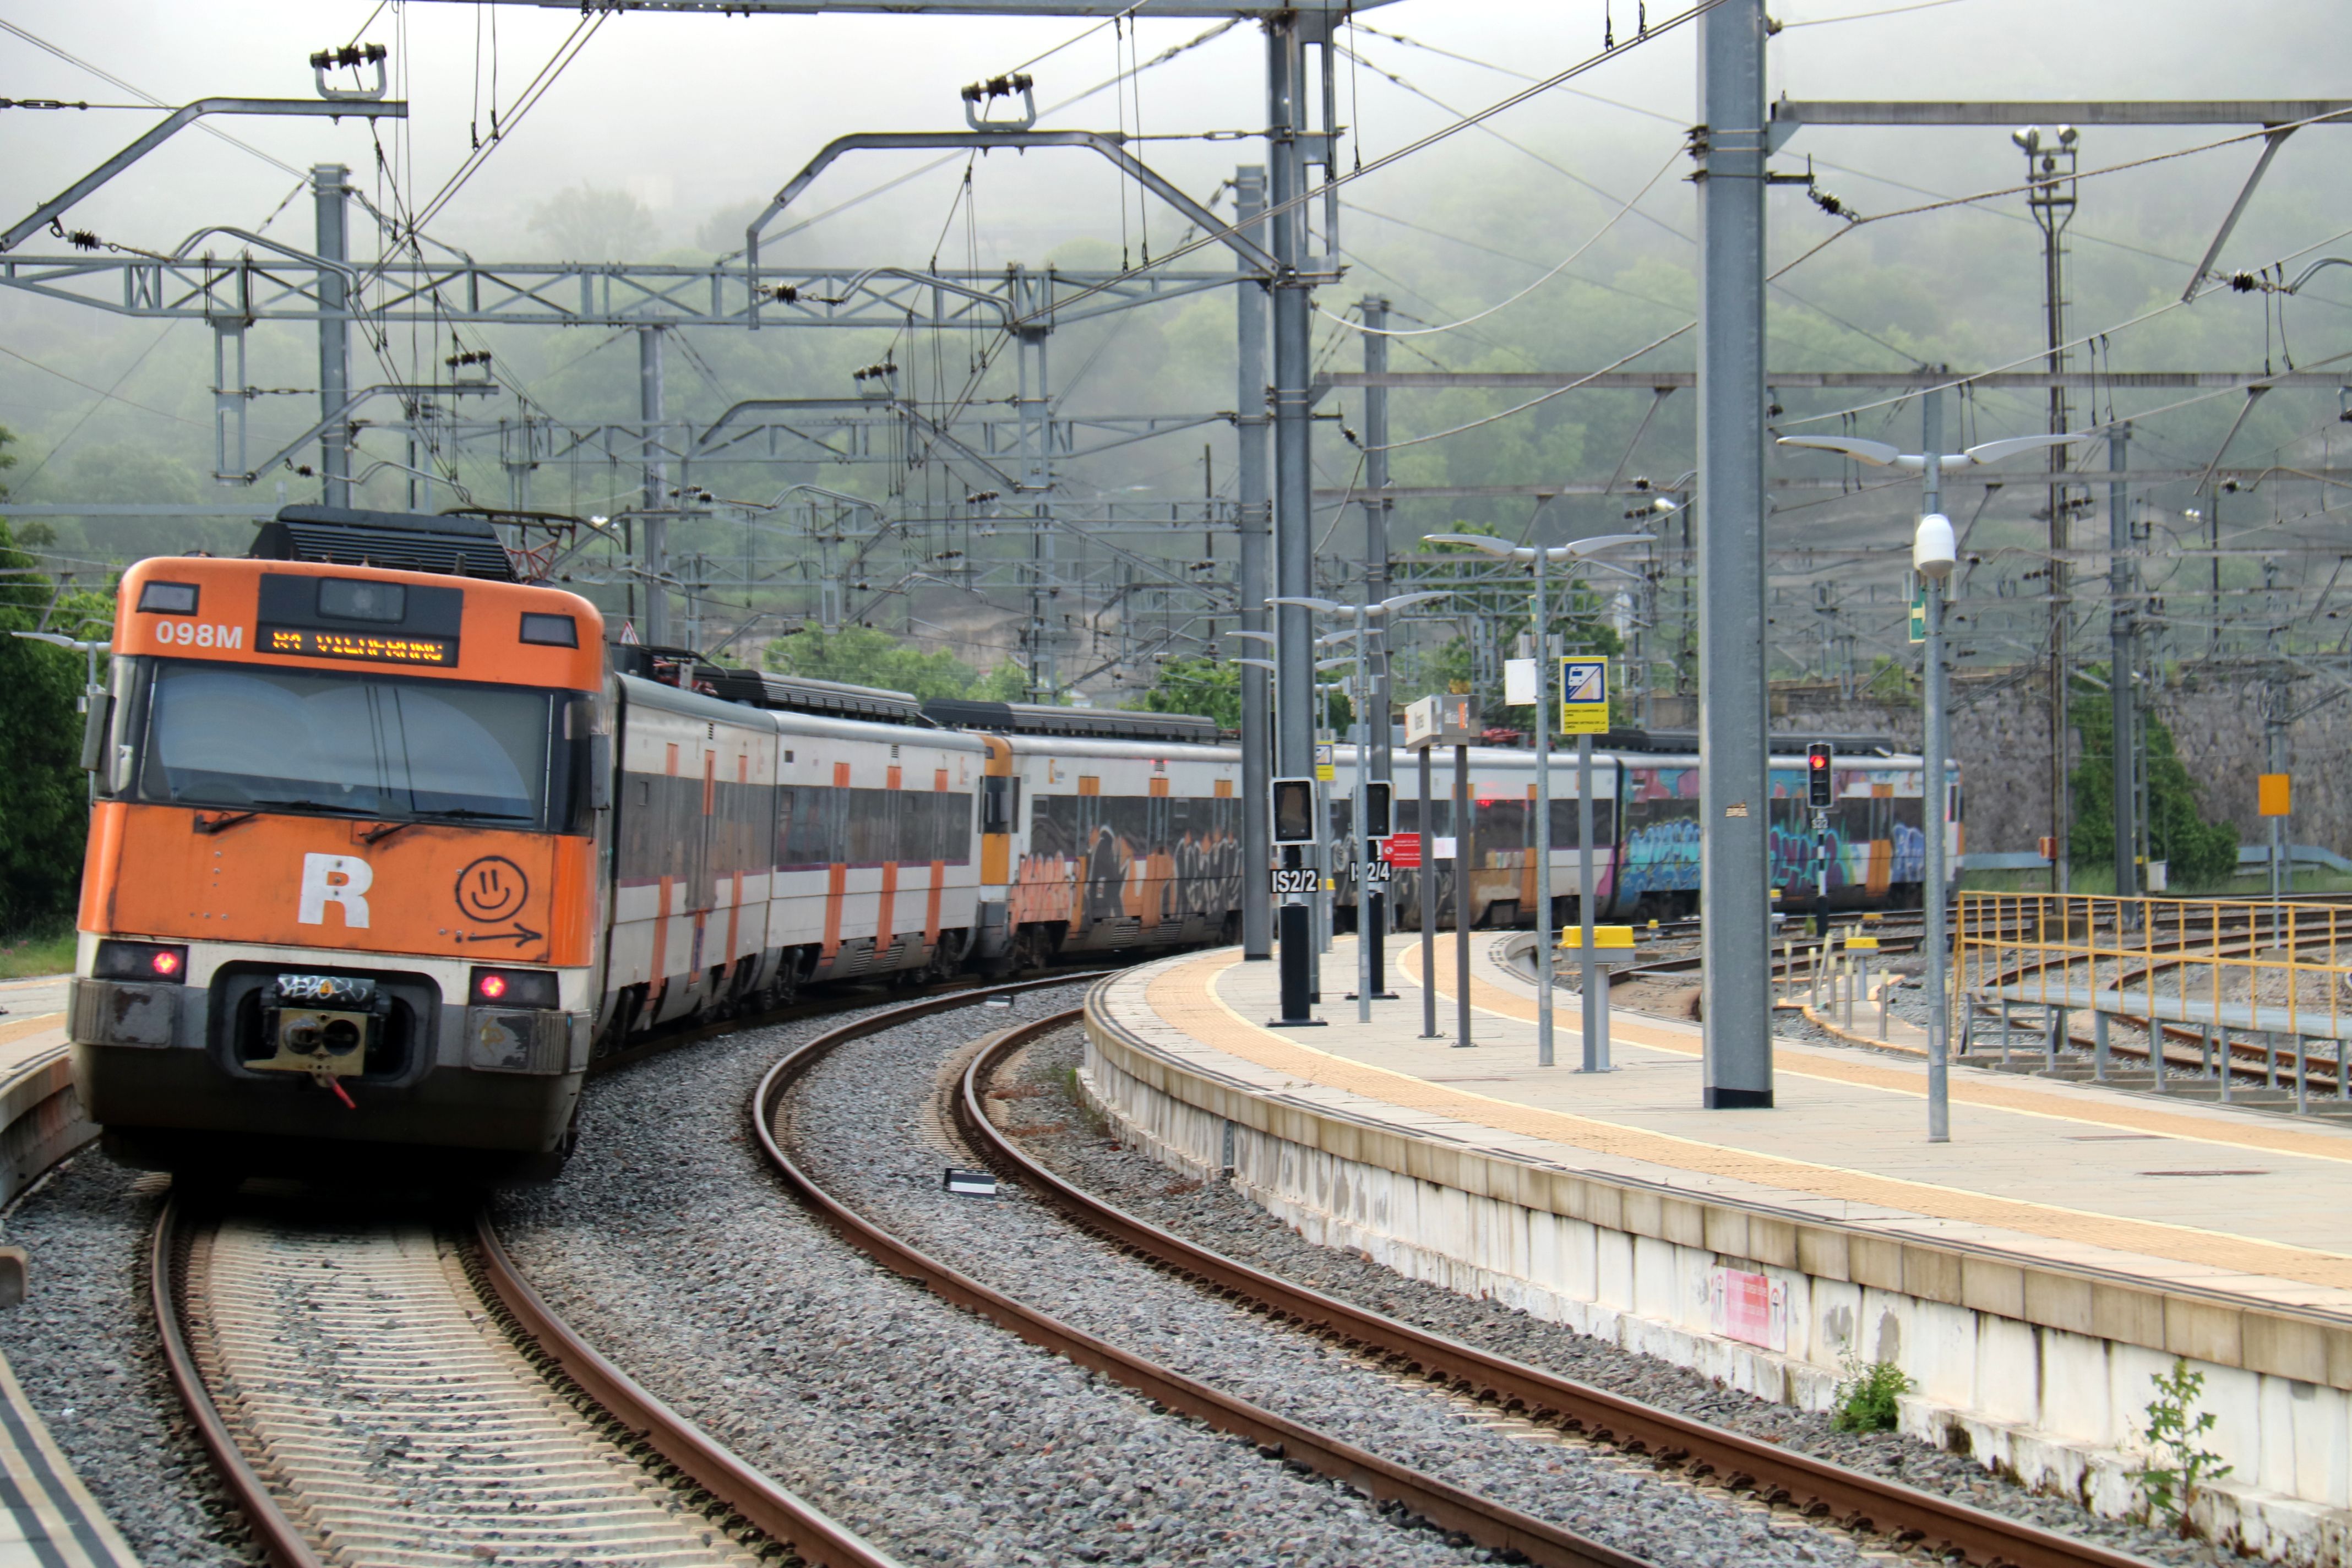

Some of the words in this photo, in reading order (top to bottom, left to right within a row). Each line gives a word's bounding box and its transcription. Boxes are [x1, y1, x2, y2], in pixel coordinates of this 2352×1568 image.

[156, 620, 243, 650] 098M
[1272, 869, 1317, 893] IS2/2
[1351, 862, 1391, 881] I2/4
[297, 852, 374, 929] R
